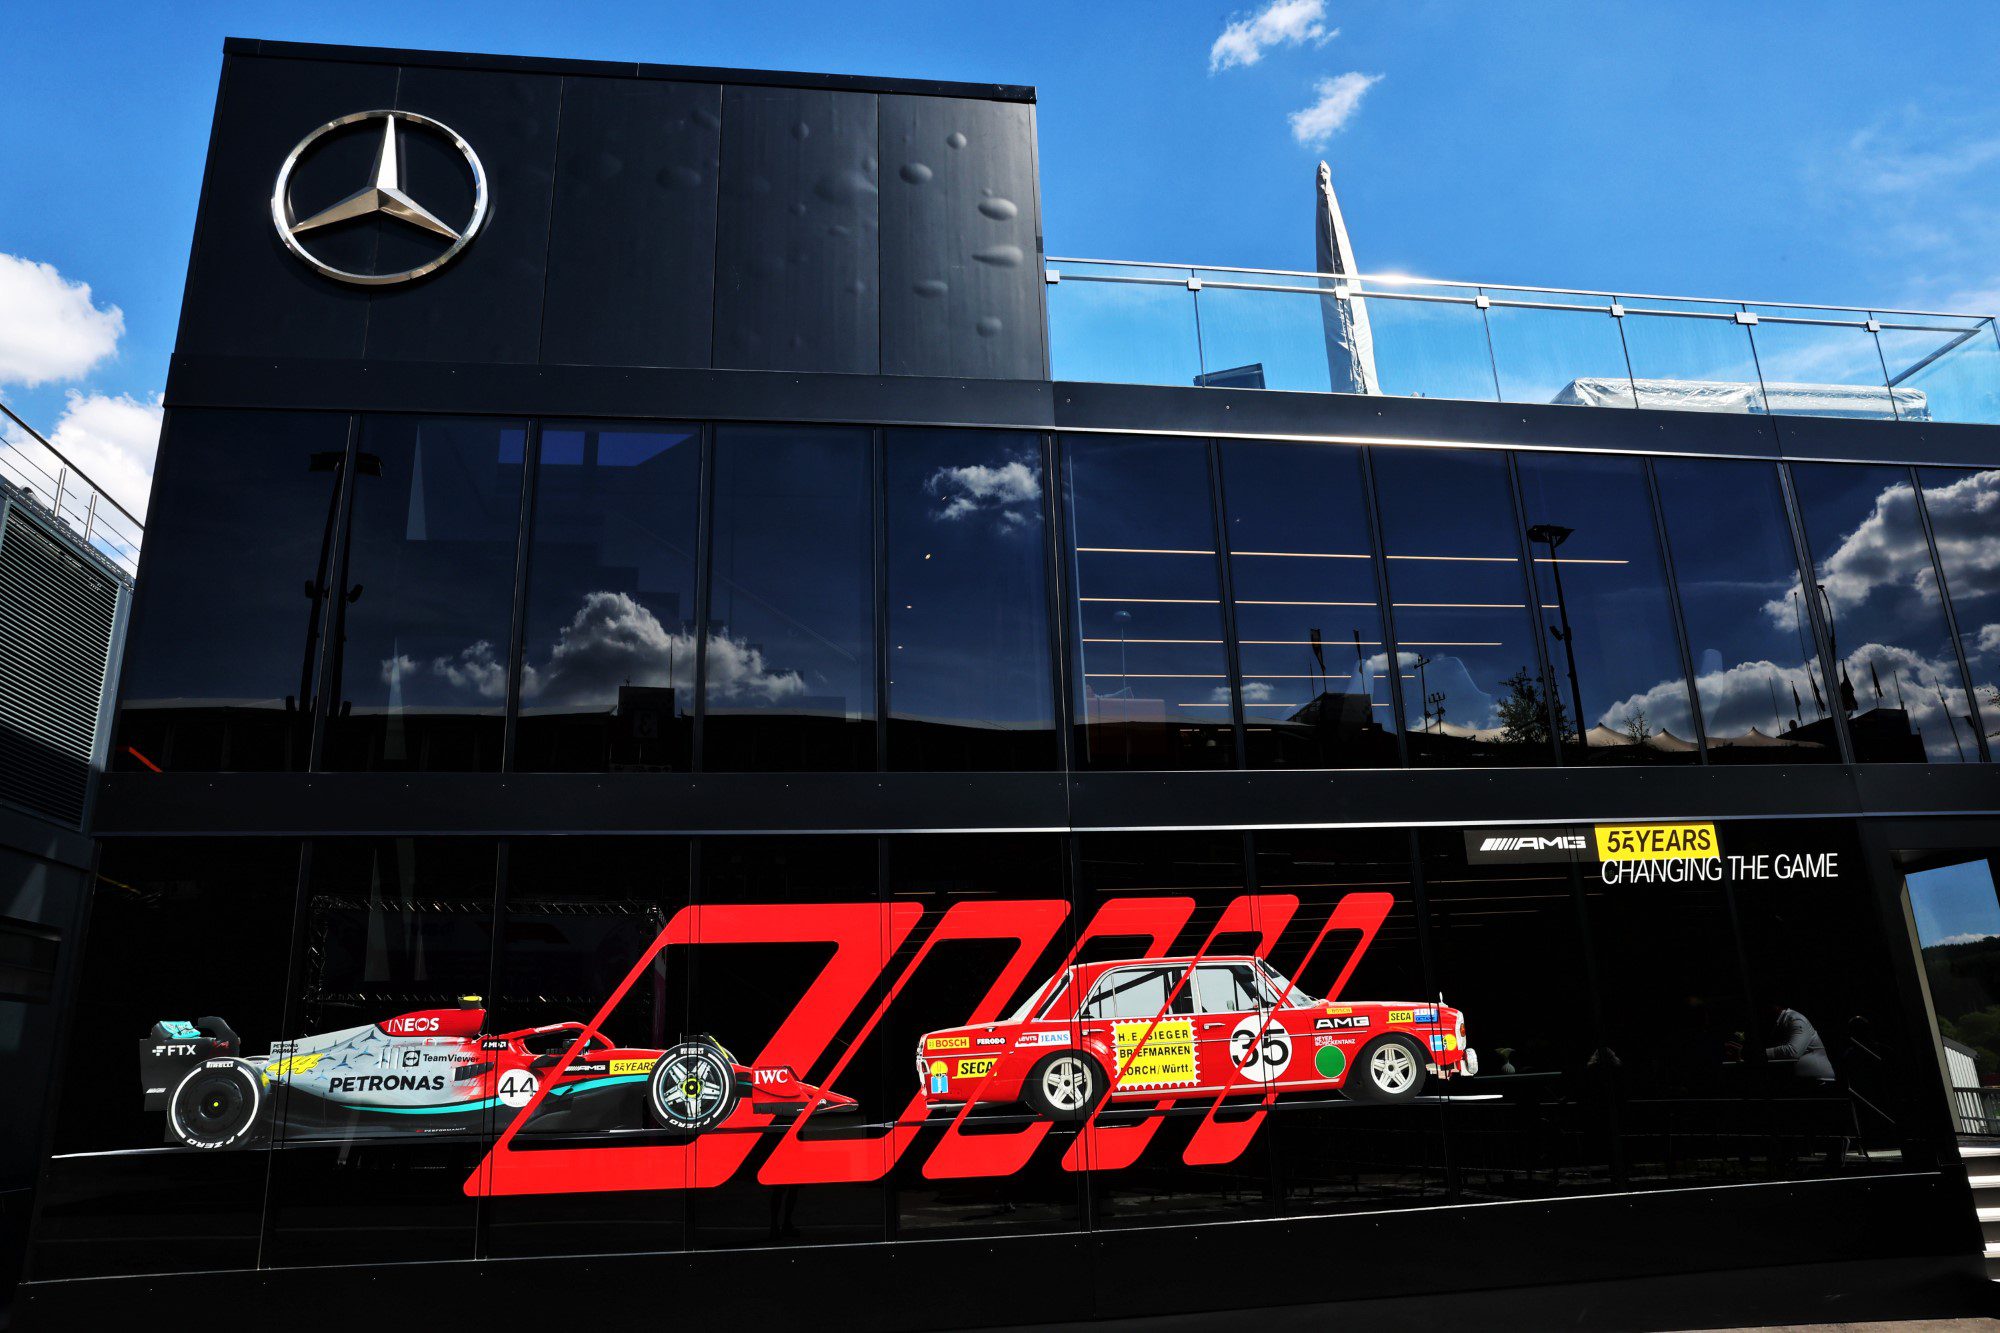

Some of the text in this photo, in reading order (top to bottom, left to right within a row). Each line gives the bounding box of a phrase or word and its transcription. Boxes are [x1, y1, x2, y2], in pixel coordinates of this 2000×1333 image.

[1601, 852, 1839, 885] CHANGING THE GAME
[1314, 1016, 1370, 1029] AMG
[1390, 1012, 1412, 1021] SECA
[387, 1017, 440, 1033] INEOS
[935, 1039, 967, 1048] BOSCH
[1040, 1034, 1069, 1043] JEANS
[167, 1044, 196, 1056] FTX
[1119, 1046, 1191, 1058] BREFMARKEN
[1231, 1028, 1289, 1068] 35
[422, 1053, 481, 1063] TeamViewer
[754, 1068, 789, 1085] IWC
[328, 1074, 445, 1093] PETRONAS
[499, 1076, 538, 1098] 44
[186, 1138, 224, 1149] ZERO
